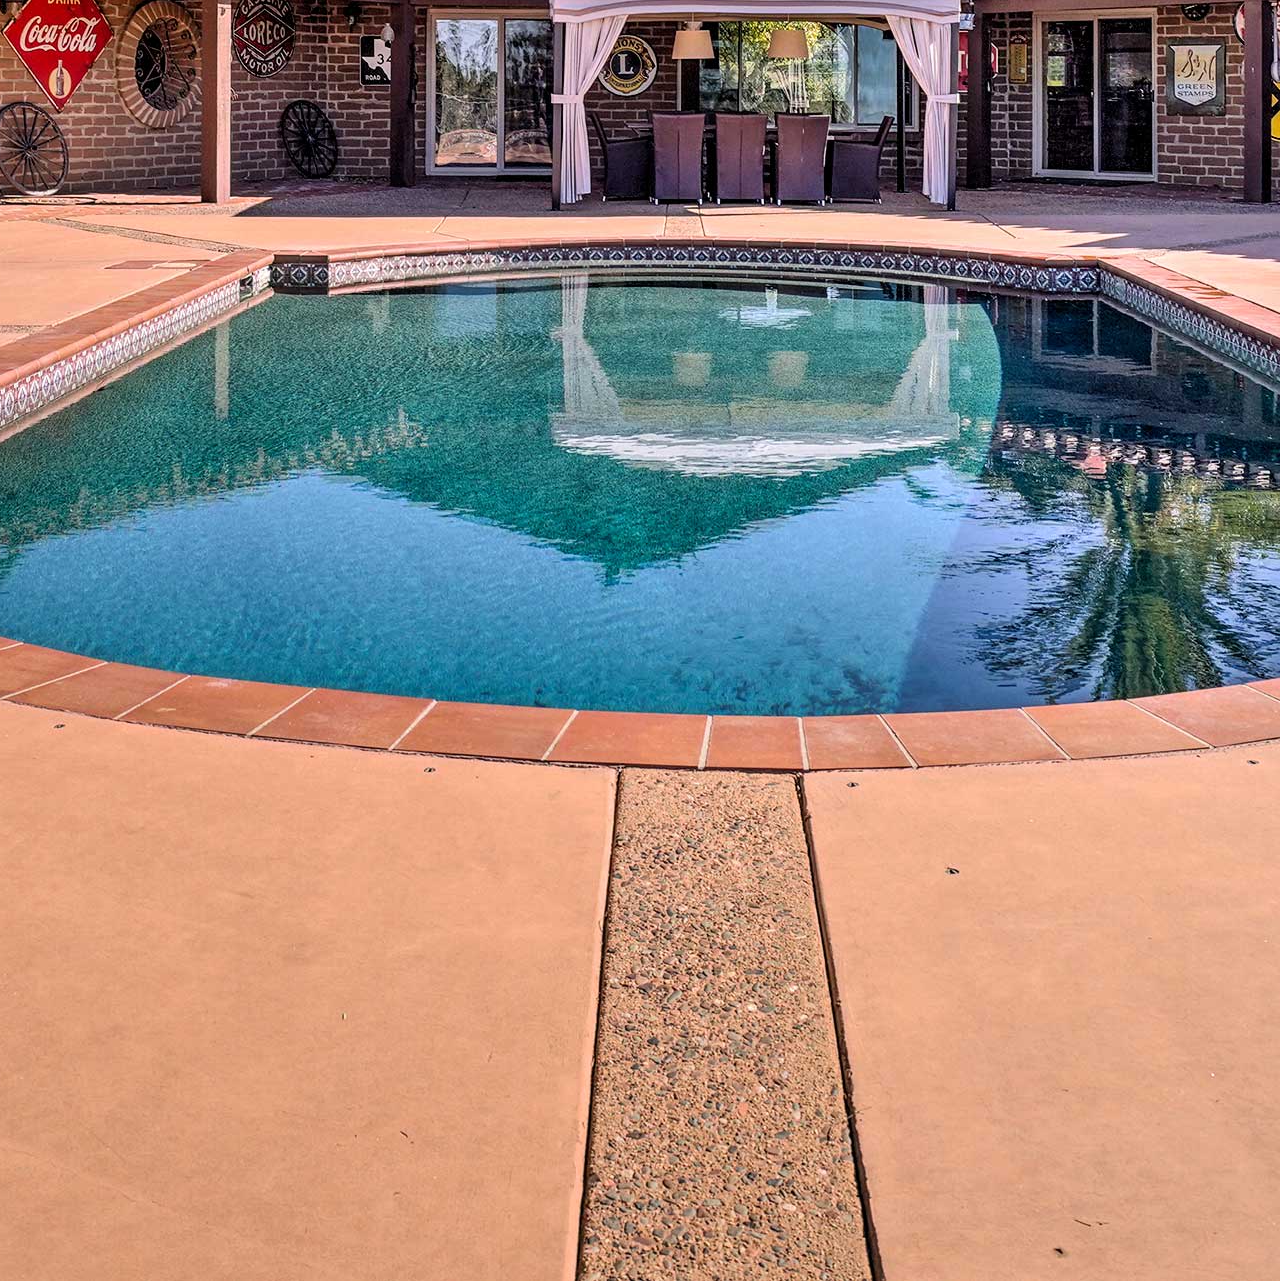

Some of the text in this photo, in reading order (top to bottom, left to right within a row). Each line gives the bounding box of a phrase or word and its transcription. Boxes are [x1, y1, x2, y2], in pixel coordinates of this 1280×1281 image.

[19, 15, 101, 52] Coca-Cola
[243, 20, 286, 46] LORECO
[240, 48, 289, 73] MOTOR OIL
[617, 53, 635, 75] L
[1177, 90, 1215, 98] STAMPS
